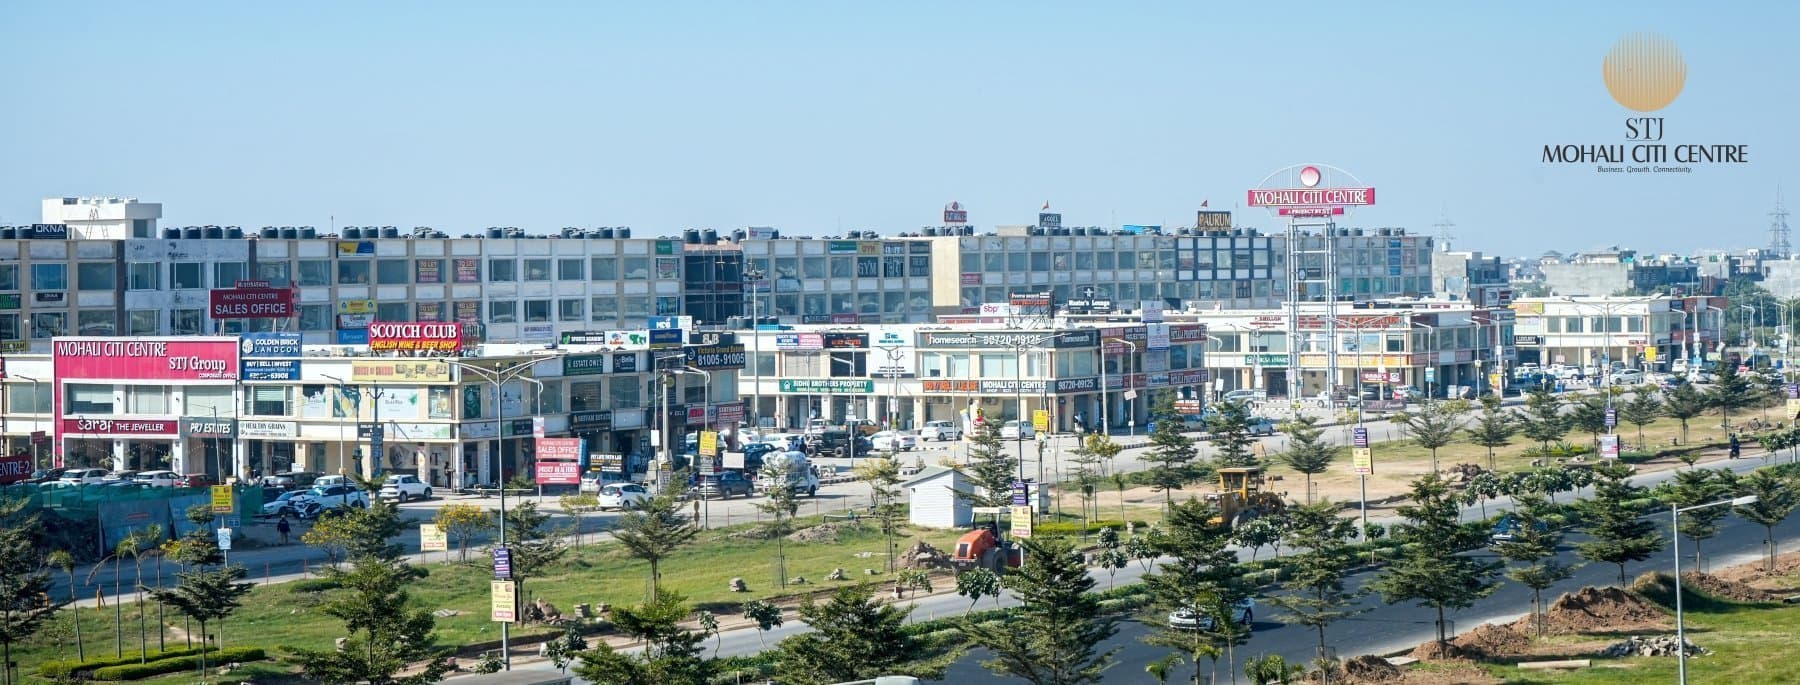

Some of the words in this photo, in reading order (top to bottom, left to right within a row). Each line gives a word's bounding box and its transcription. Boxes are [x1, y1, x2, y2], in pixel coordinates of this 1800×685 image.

[1254, 192, 1299, 205] MOHALI
[1302, 191, 1323, 204] CITI
[1326, 190, 1367, 204] CENTRE
[858, 262, 877, 276] GYM
[215, 304, 248, 314] SALES
[250, 303, 286, 313] OFFICE
[370, 323, 422, 338] SCOTCH
[423, 323, 457, 338] CLUB
[255, 338, 279, 346] GOLDEN
[280, 338, 298, 346] BRICK
[371, 340, 398, 349] ENGLISH
[398, 340, 415, 349] WINE
[421, 340, 439, 349] BEER
[439, 340, 458, 349] SHOP
[928, 334, 977, 345] homesearch
[58, 342, 101, 357] MOHALI
[104, 342, 124, 357] CITI
[127, 342, 167, 357] CENTRE
[168, 356, 188, 371] STJ
[190, 356, 227, 372] Group
[697, 353, 745, 366] 81005-91005
[983, 380, 1006, 389] MOHALI
[116, 423, 130, 431] THE
[131, 423, 164, 431] JEWELLER
[204, 423, 231, 434] ESTATES
[538, 446, 557, 454] SALES
[557, 446, 579, 454] OFFICE
